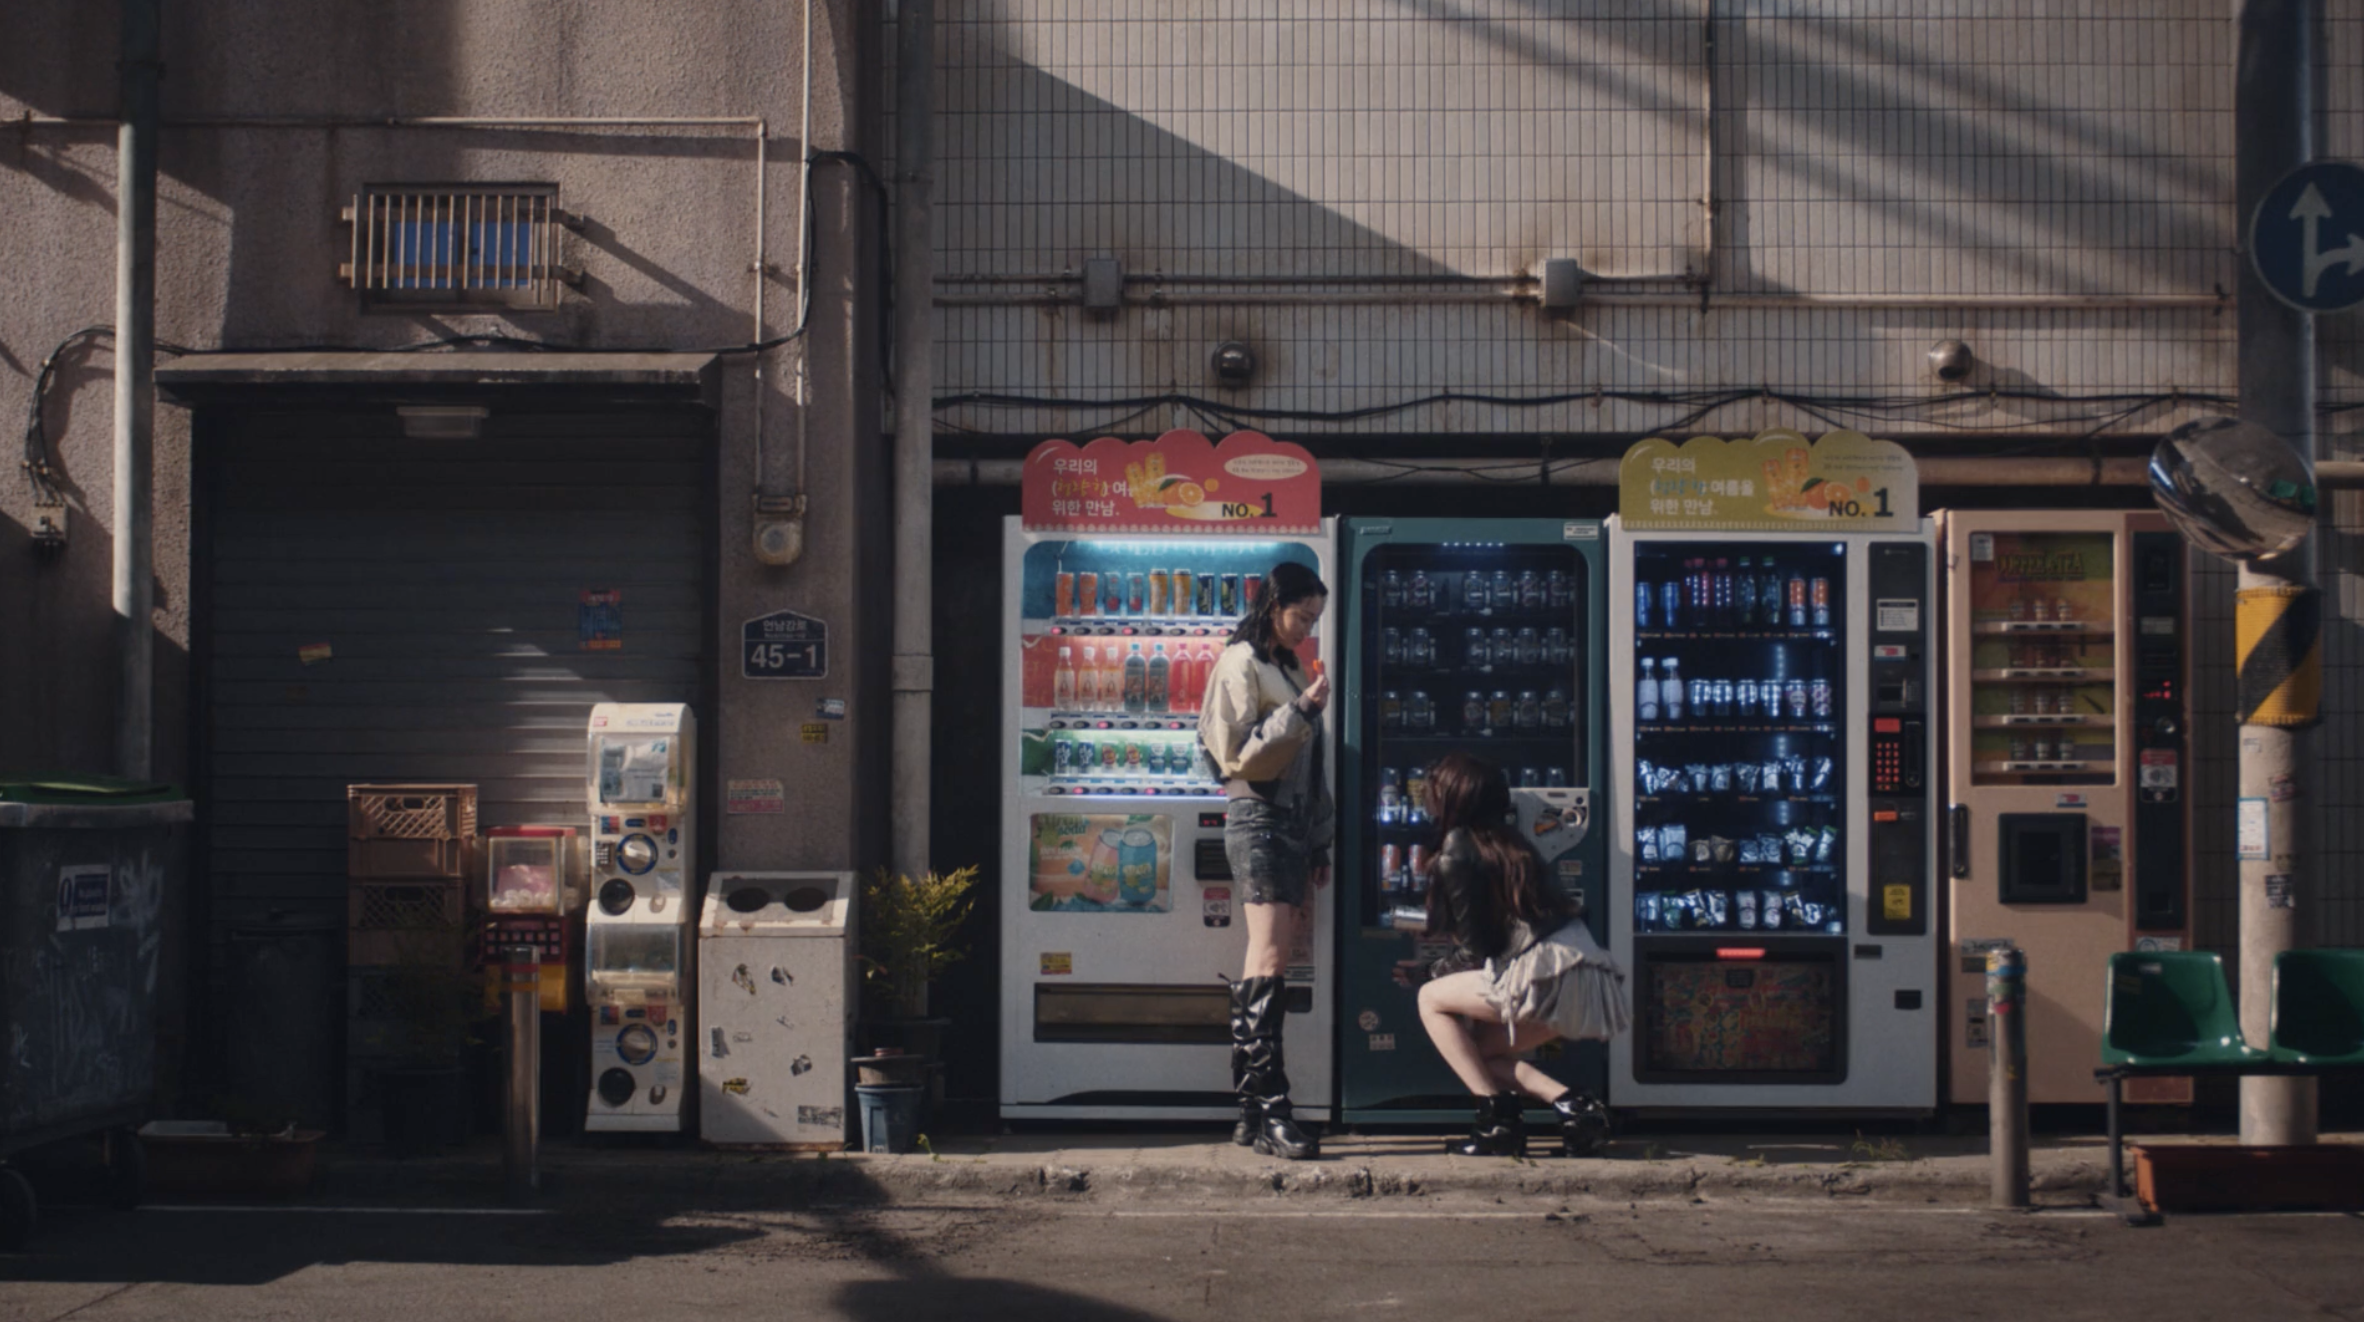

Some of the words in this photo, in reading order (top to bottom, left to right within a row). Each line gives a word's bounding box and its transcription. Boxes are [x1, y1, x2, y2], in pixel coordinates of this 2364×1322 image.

[1053, 458, 1098, 475] 우리의
[1651, 457, 1696, 474] 우리의
[1112, 480, 1134, 497] 여
[1052, 499, 1081, 516] 위한
[1085, 499, 1120, 517] 만남.
[1650, 498, 1679, 516] 위한
[1682, 498, 1719, 516] 만남.
[751, 644, 816, 668] 45-1
